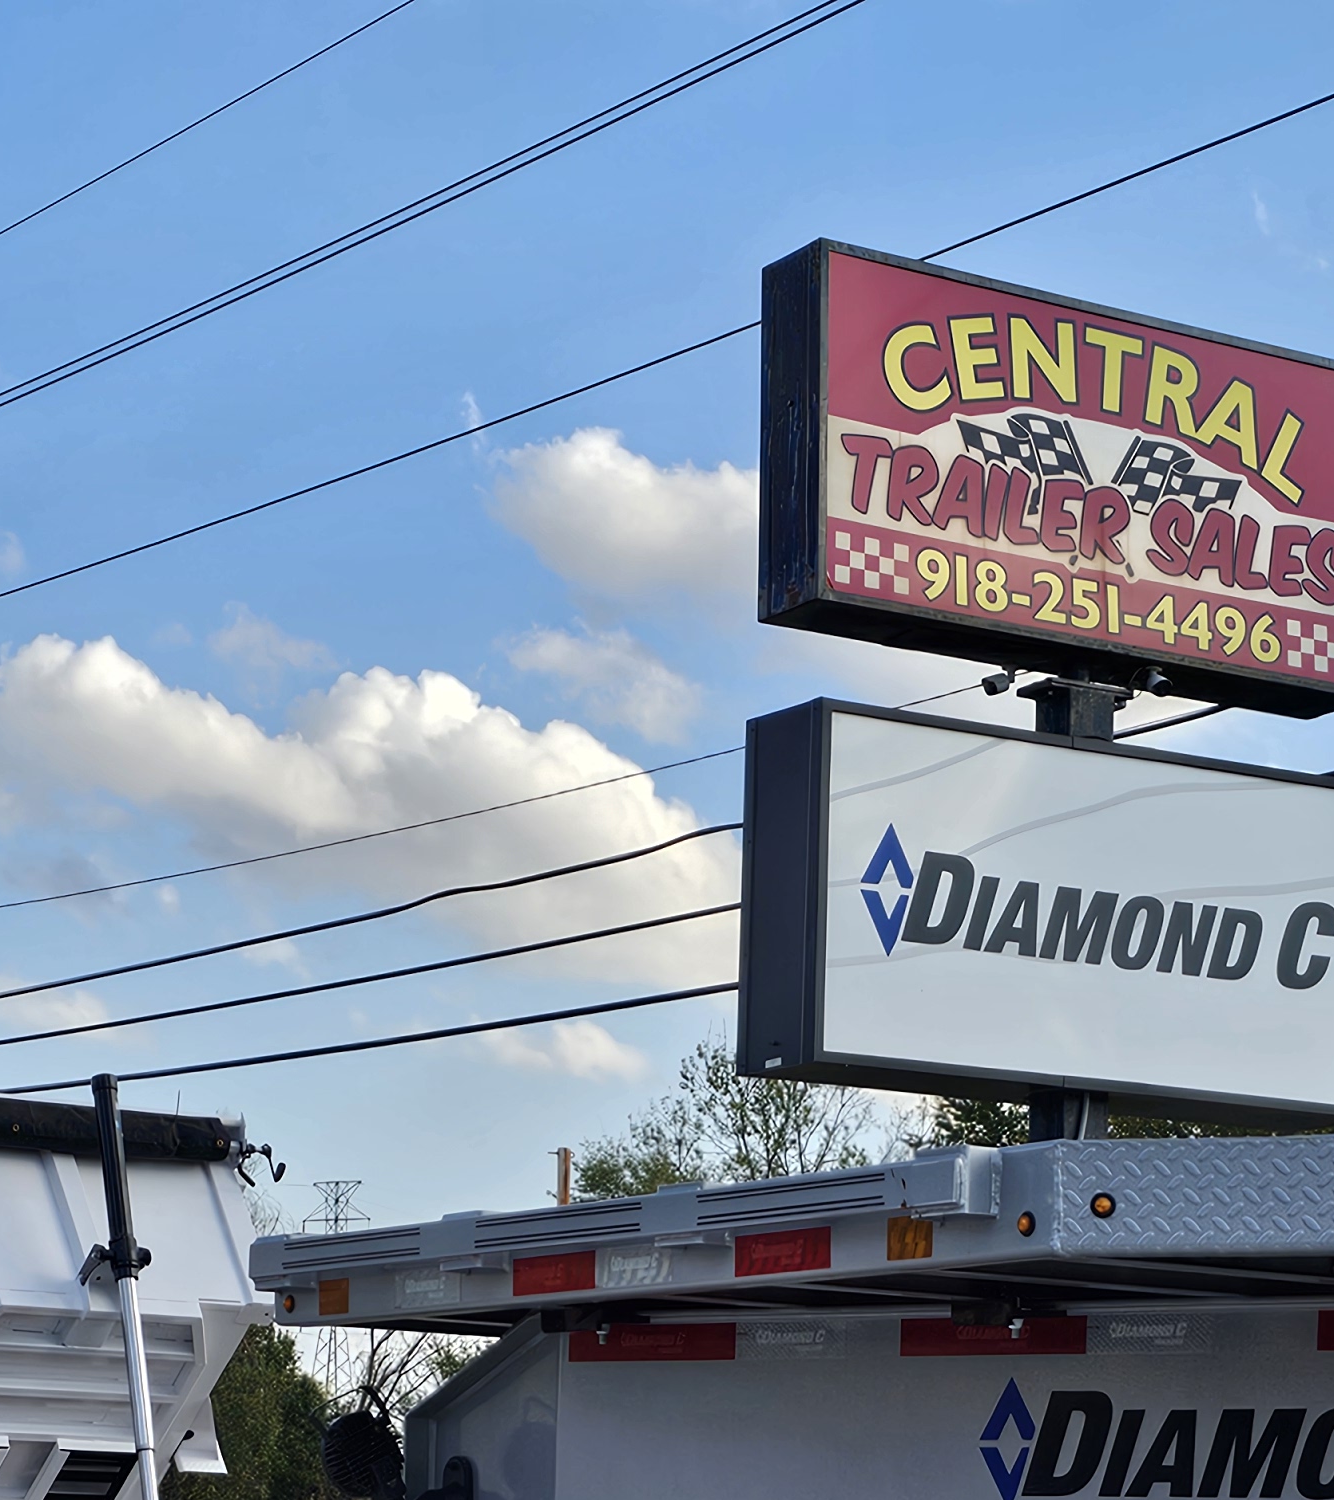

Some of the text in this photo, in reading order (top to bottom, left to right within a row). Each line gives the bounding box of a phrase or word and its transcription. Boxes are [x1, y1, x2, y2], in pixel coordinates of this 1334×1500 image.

[882, 313, 1305, 506] CENTRAL
[840, 432, 1132, 566] TRAILER
[915, 548, 1281, 664] 918-251-4496
[901, 851, 1264, 981] DIAMOND
